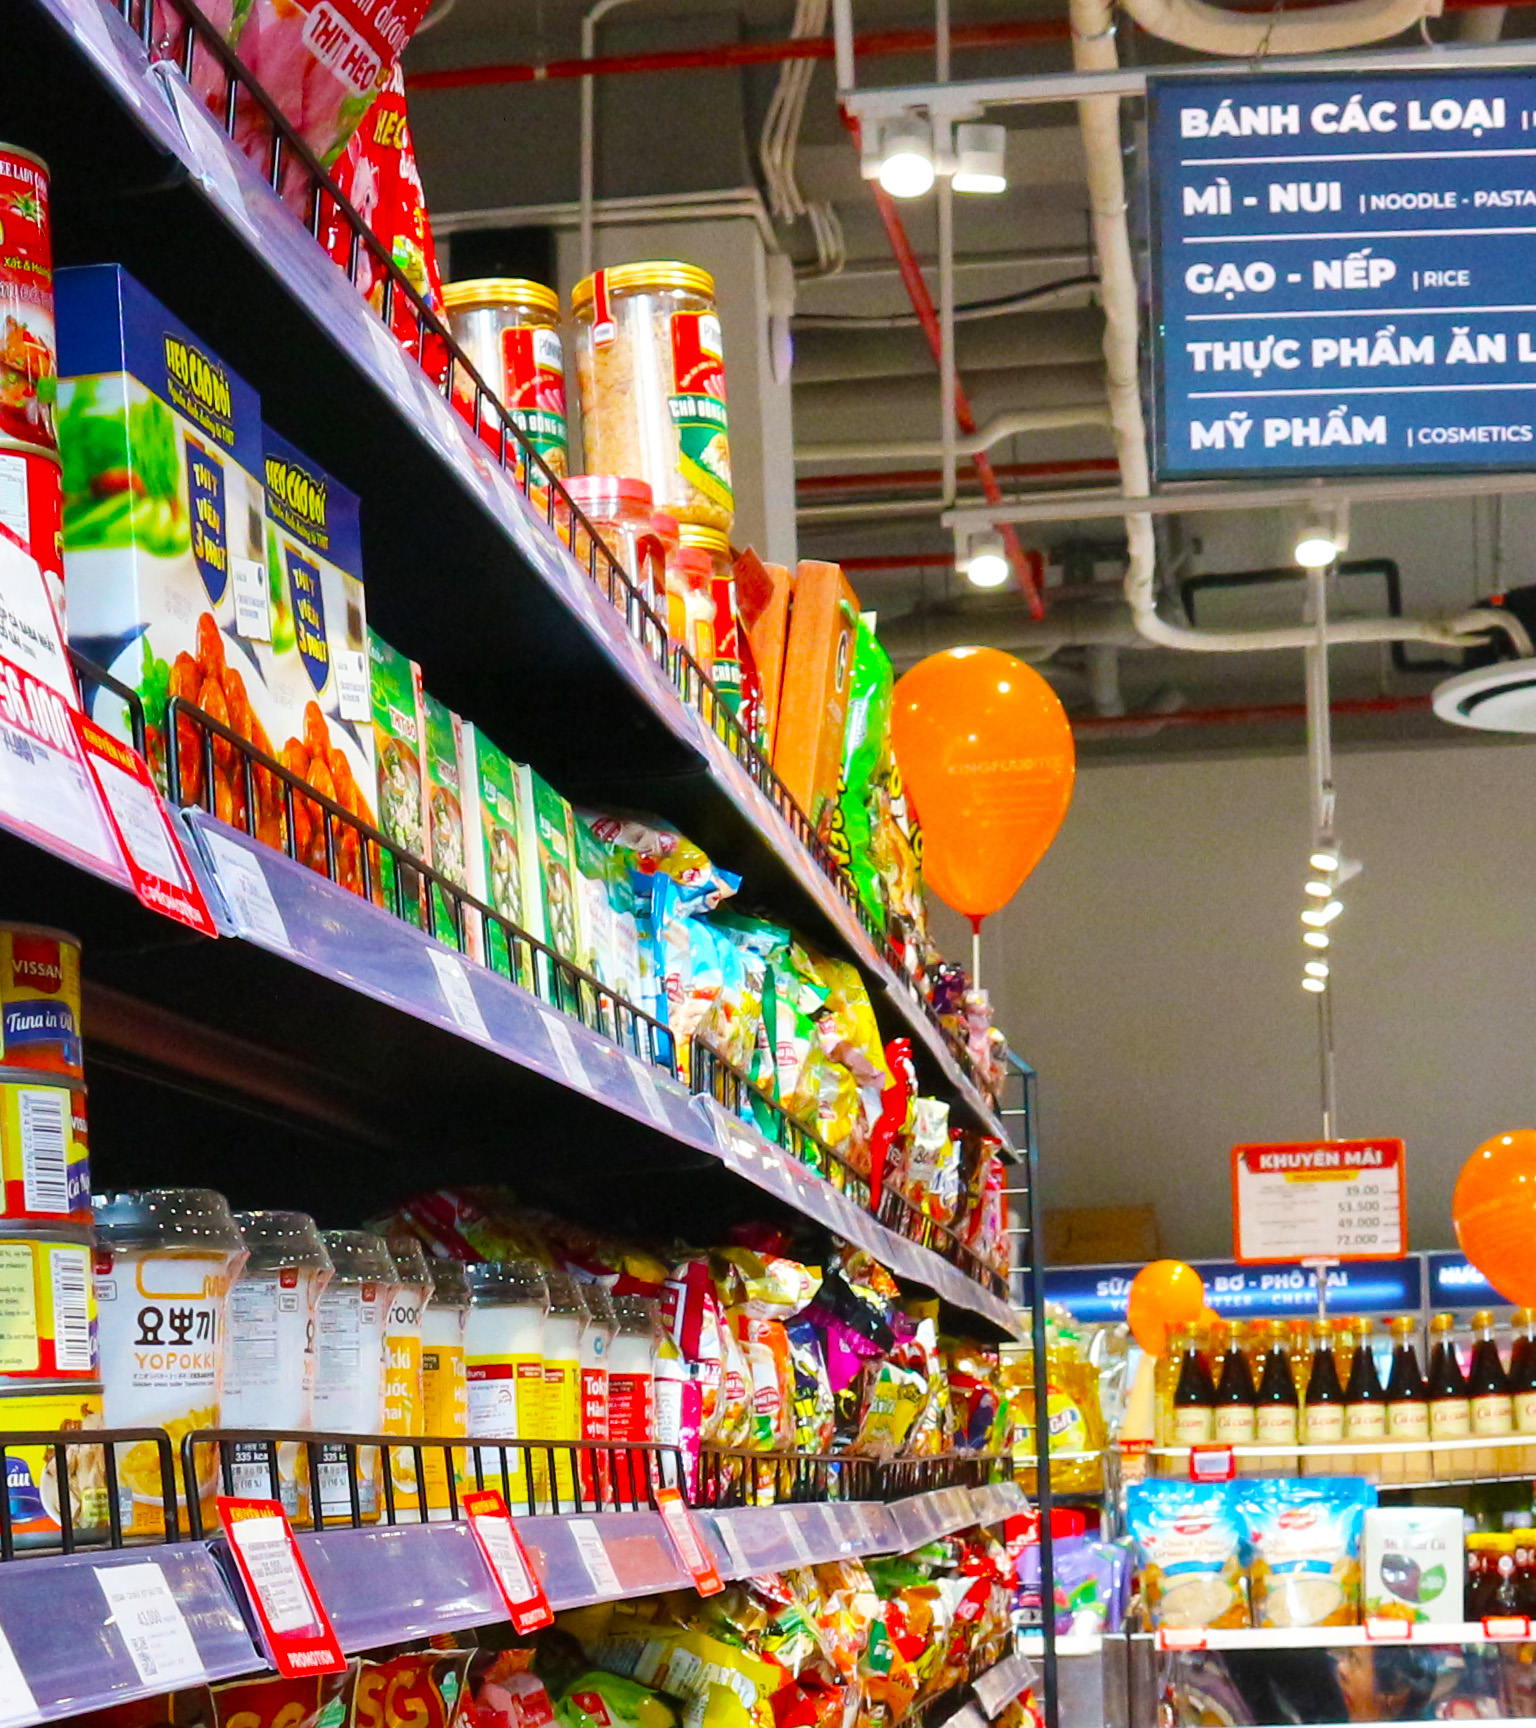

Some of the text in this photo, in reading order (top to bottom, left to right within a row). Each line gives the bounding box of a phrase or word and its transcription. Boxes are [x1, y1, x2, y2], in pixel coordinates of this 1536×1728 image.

[1181, 98, 1300, 138] BÁNH
[1311, 95, 1397, 134] CÁC
[1408, 98, 1505, 139] LOẠI
[1183, 179, 1231, 216] MÌ
[1269, 183, 1343, 214] NUI
[1370, 190, 1457, 210] NOODLE
[1186, 248, 1470, 301] GẠO NẾP RICE
[165, 337, 189, 381] HEO
[1187, 334, 1301, 379] THỰC
[1312, 323, 1435, 368] PHẨM
[1447, 324, 1506, 364] ĂN
[1189, 405, 1533, 450] MỸ PHẨM COSMETICS
[266, 456, 286, 499] HEO
[11, 957, 64, 982] VISSAN
[6, 1010, 42, 1033] Tuna
[287, 1648, 335, 1669] PROMOTION
